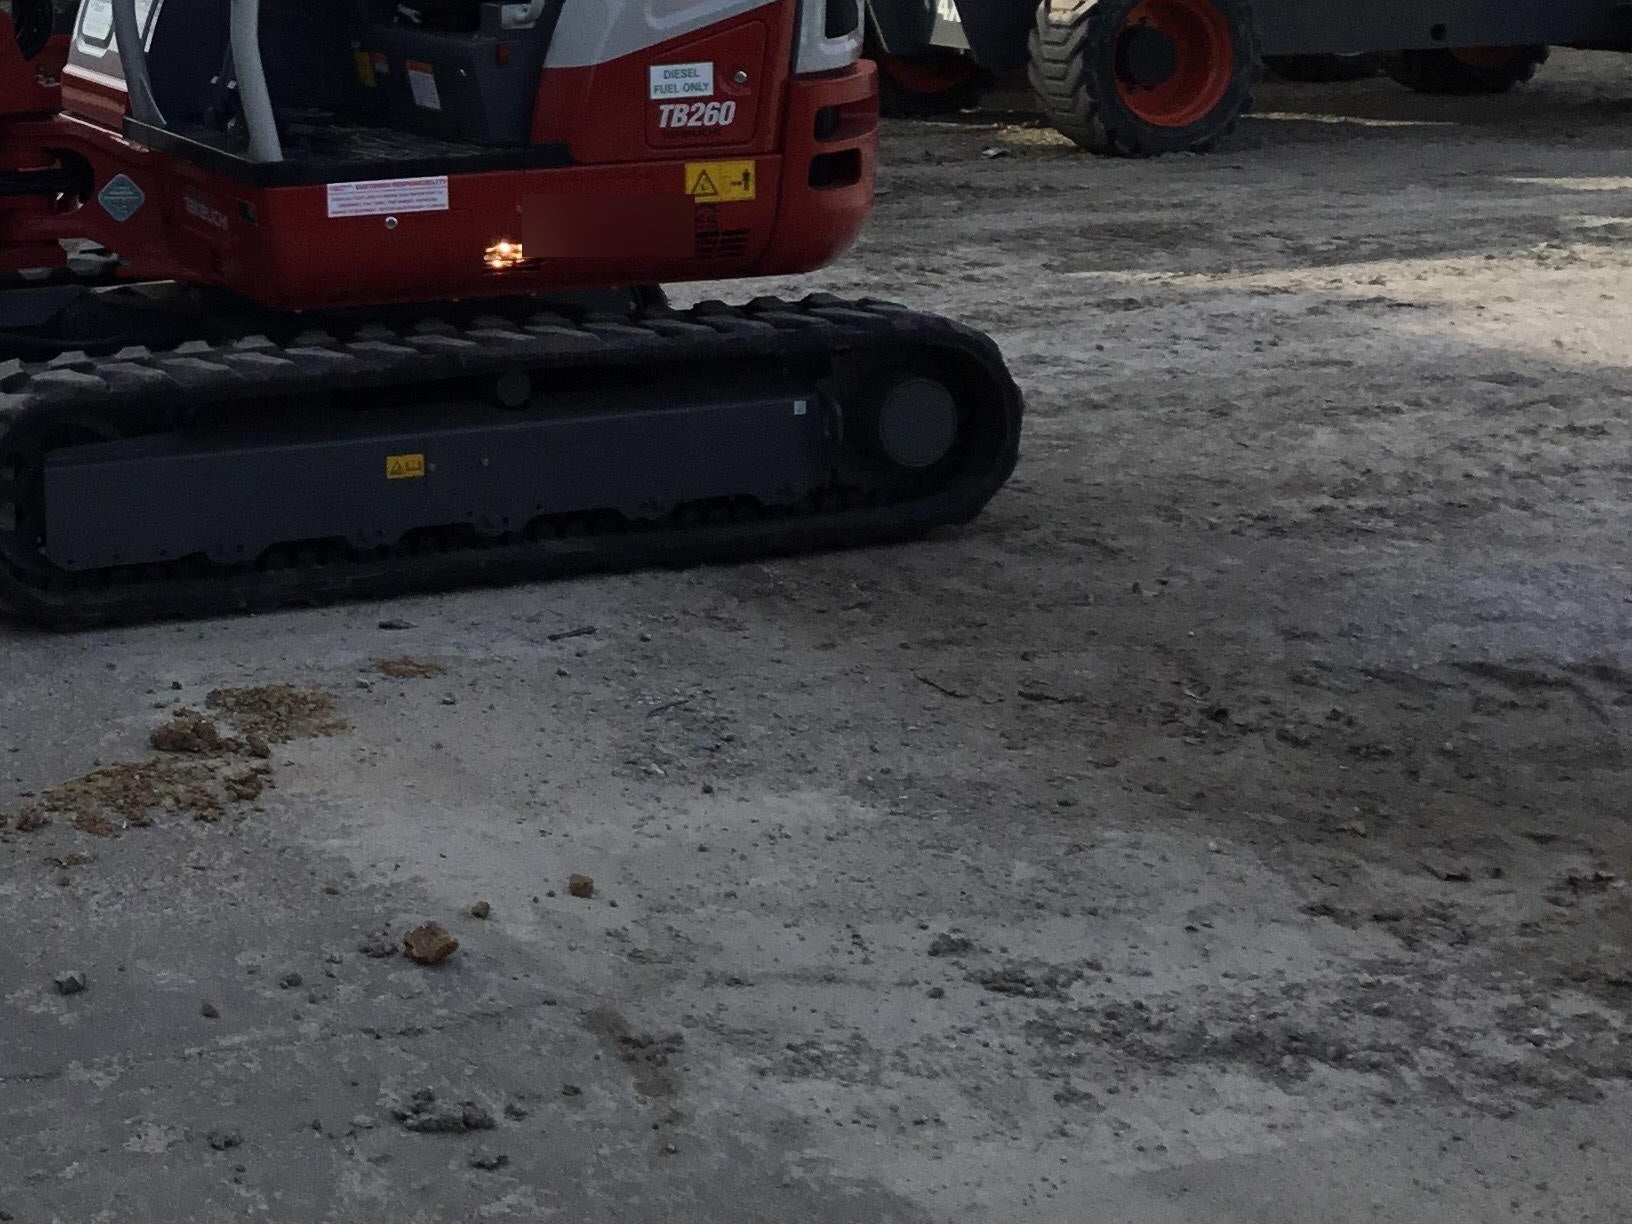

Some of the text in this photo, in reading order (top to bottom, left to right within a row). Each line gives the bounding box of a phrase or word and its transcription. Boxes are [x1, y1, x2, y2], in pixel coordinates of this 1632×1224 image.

[663, 68, 701, 80] DIESEL
[653, 82, 710, 95] FUEL ONLY
[659, 101, 737, 129] TB260
